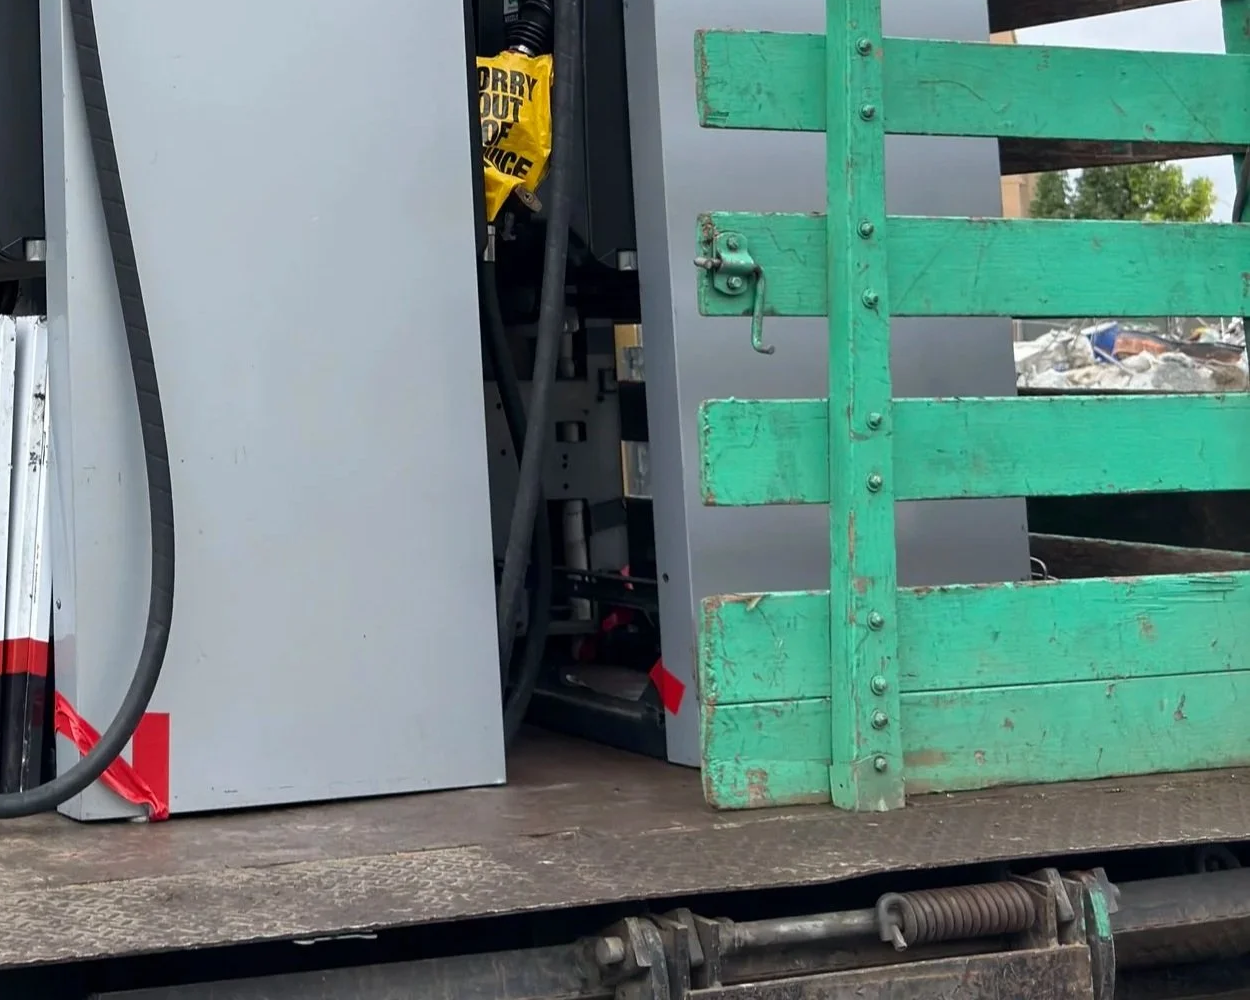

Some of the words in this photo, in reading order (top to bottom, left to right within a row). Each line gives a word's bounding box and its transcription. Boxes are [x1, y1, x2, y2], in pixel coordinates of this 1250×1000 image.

[477, 66, 539, 102] ORRY
[479, 91, 523, 123] OUT
[481, 119, 514, 146] OF
